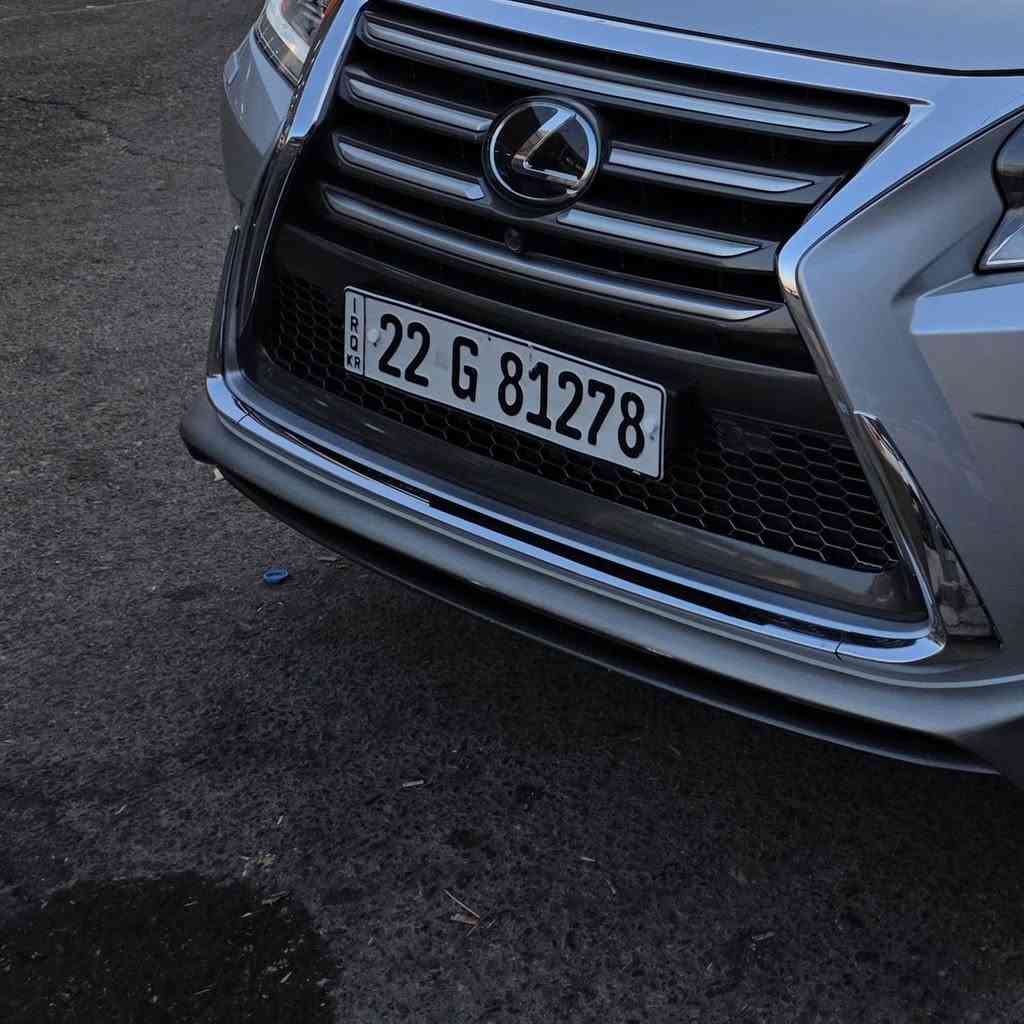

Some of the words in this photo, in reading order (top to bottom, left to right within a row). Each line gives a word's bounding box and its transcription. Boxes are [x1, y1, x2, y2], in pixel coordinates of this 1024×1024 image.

[378, 313, 431, 388] 22
[451, 336, 479, 402] G
[497, 351, 645, 459] 81278
